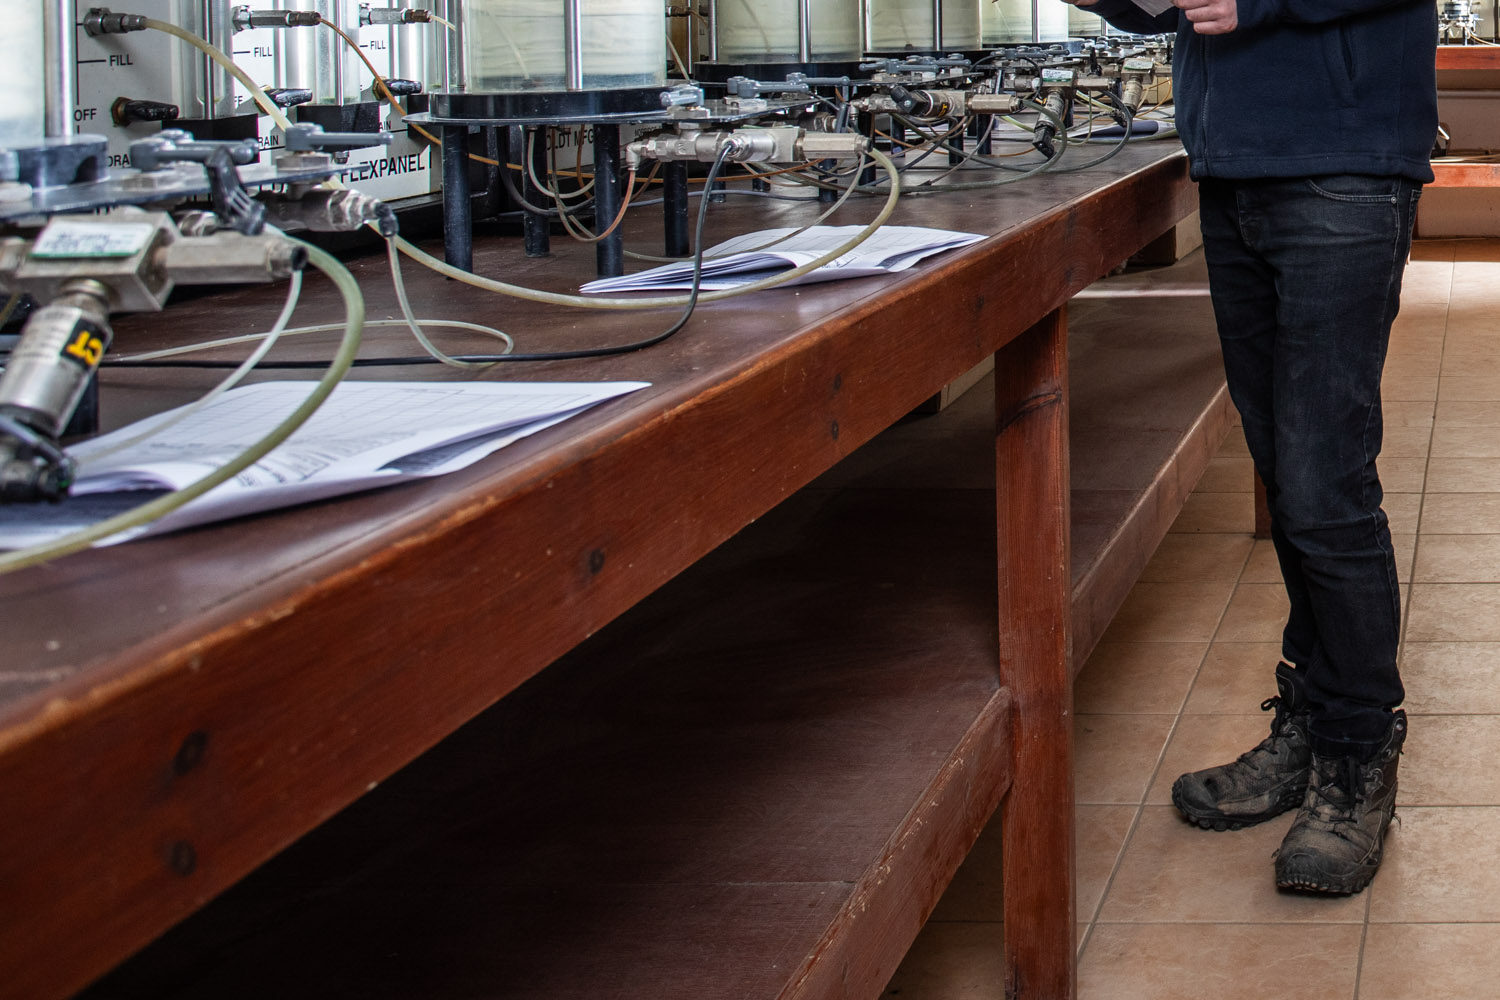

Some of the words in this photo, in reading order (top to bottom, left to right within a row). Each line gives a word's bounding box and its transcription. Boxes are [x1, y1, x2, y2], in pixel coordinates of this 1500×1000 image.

[369, 40, 387, 50] FILL
[253, 46, 273, 57] FILL
[109, 54, 134, 67] FILL
[73, 108, 98, 122] OFF
